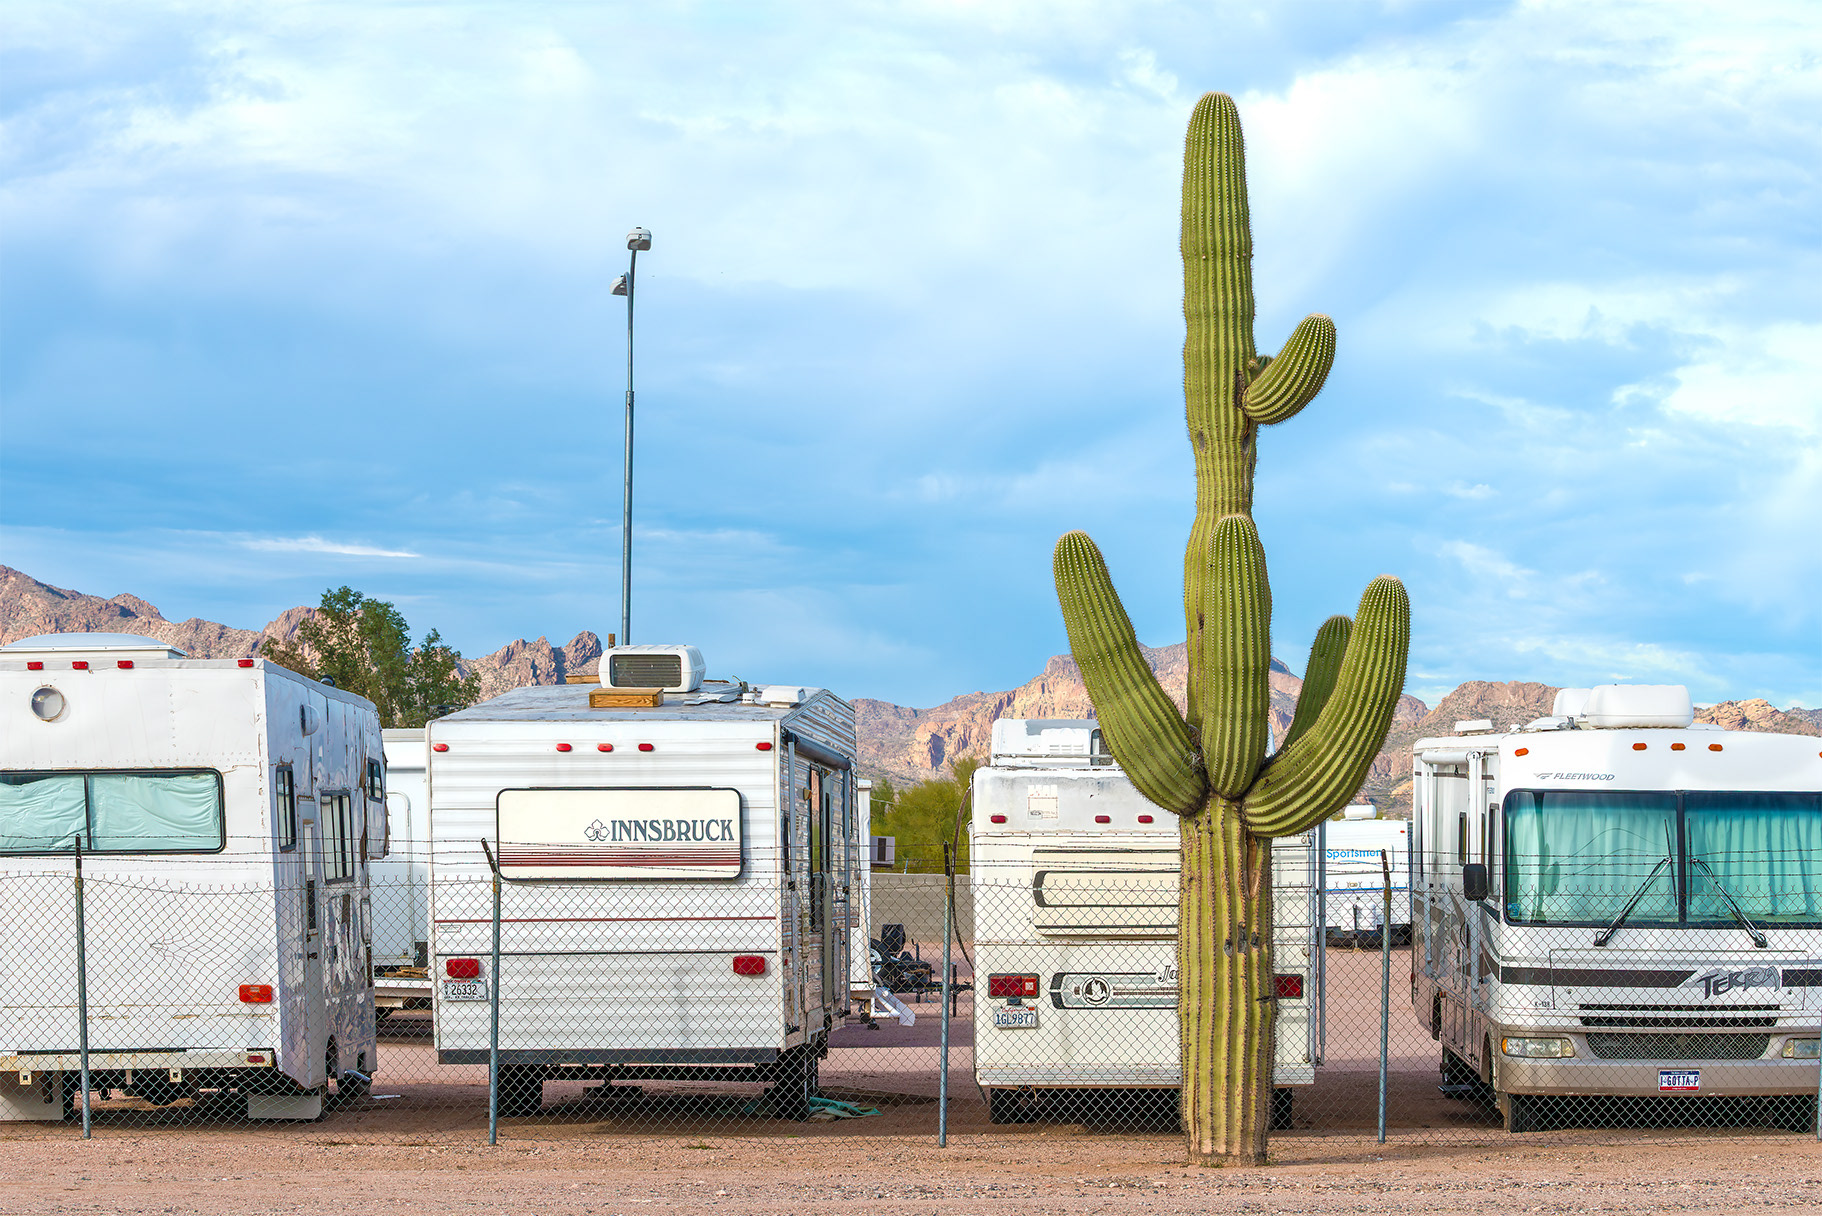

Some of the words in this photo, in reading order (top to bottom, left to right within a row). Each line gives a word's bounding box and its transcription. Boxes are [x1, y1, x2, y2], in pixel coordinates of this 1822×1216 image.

[1553, 772, 1616, 781] FLEETWOOD
[610, 818, 735, 842] INNSBRUCK
[1326, 847, 1383, 860] Sportsmen
[451, 983, 478, 996] 26332
[995, 1012, 1035, 1025] 1GL9877
